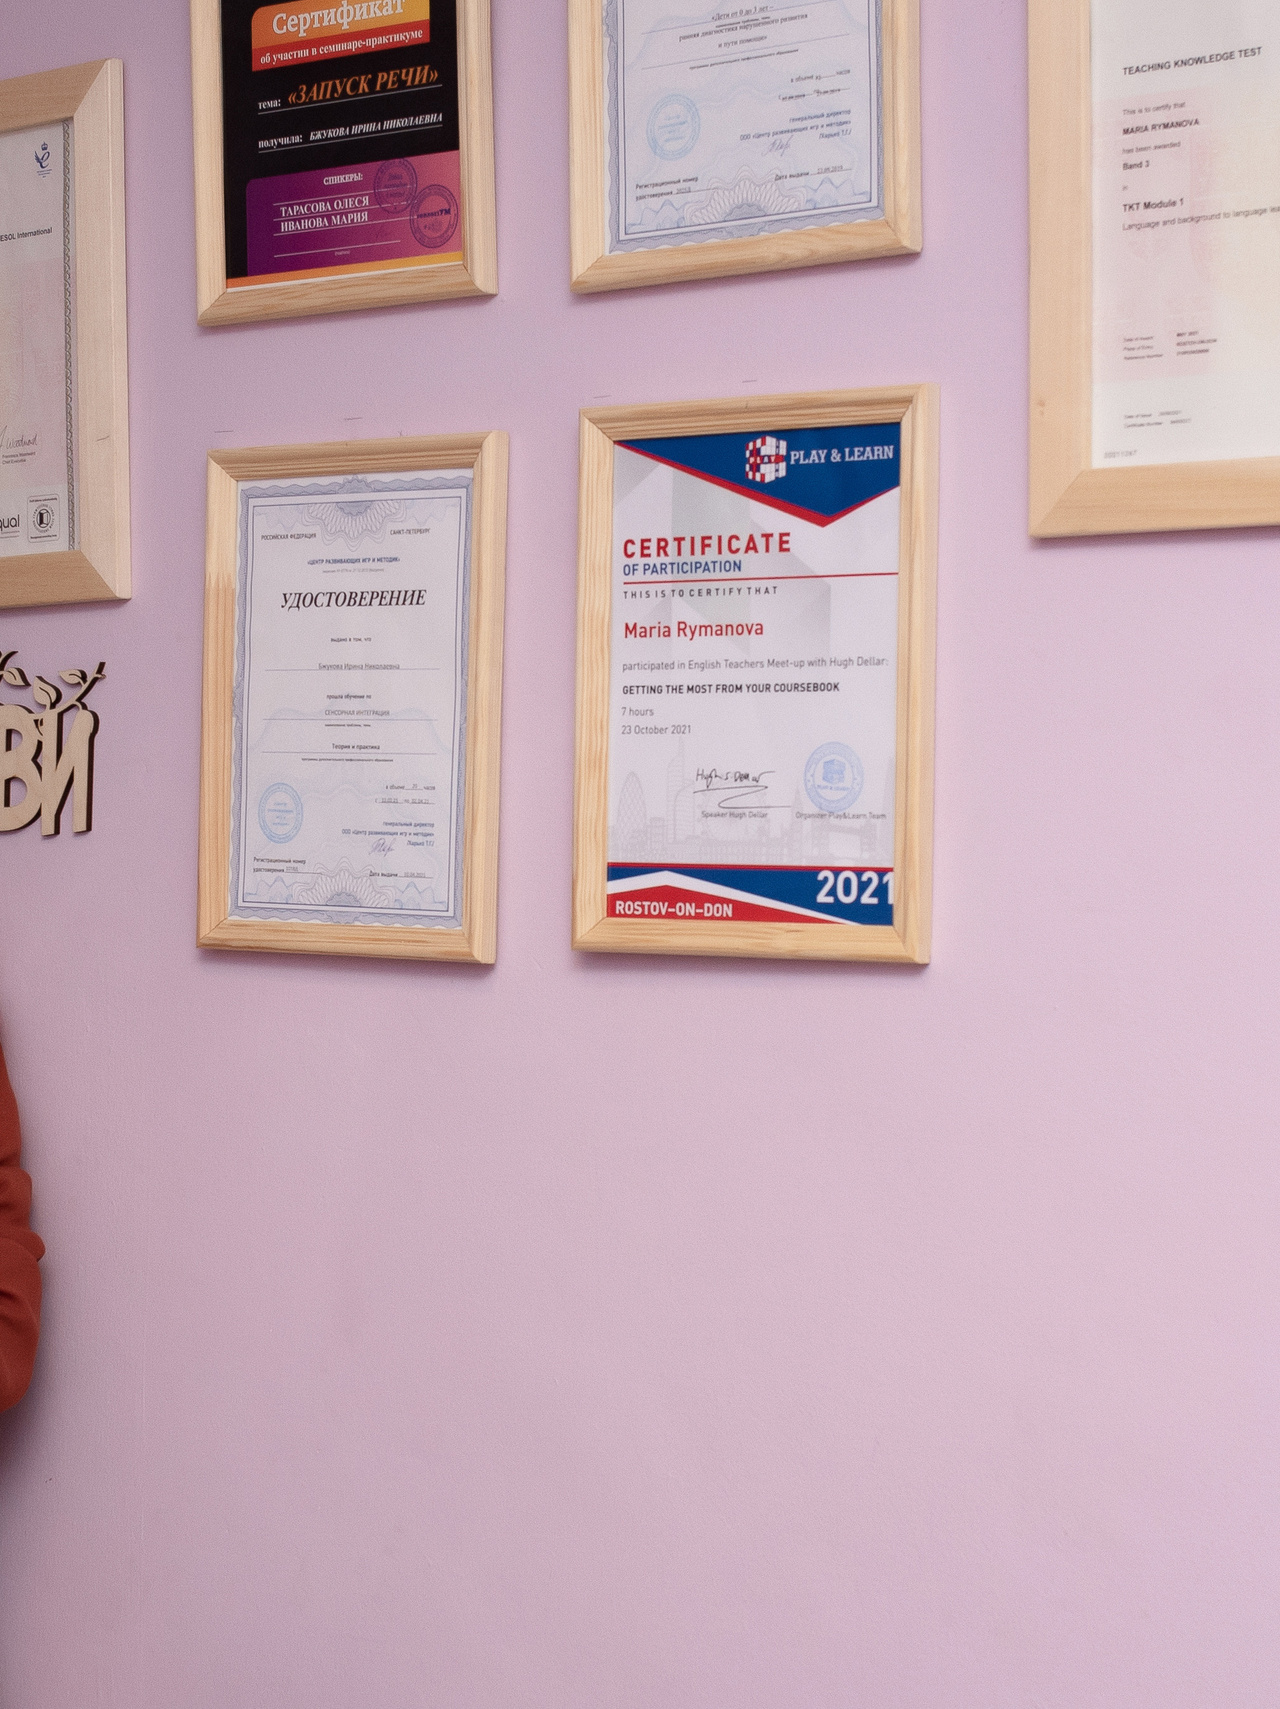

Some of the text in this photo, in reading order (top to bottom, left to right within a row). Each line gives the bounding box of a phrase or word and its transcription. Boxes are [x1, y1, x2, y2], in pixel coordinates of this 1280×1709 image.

[272, 0, 405, 37] Сертификат
[260, 53, 270, 64] об
[273, 48, 309, 65] участии
[319, 29, 423, 55] семинаре-практикуме
[1123, 47, 1262, 75] TEACHING KNOWLEDGE TEST
[258, 65, 439, 110] тема: «ЗАПУСК РЕЧИ»
[259, 113, 442, 149] получила: БЖУКОВА ИРИНА НИКОЛАЕВНА
[1123, 118, 1199, 135] MARIA RYMANOVA
[1123, 162, 1142, 170] Band
[323, 173, 362, 185] СПИКЕРЫ:
[280, 196, 369, 217] ТАРАСОВА ОЛЕСЯ
[1123, 203, 1140, 212] TKT
[1143, 200, 1177, 210] Module
[280, 212, 368, 232] ИВАНОВА МАРИЯ
[1123, 221, 1160, 231] Language
[1178, 213, 1221, 225] background
[1233, 208, 1267, 218] language
[0, 233, 16, 242] ESOL
[17, 227, 52, 239] International
[790, 445, 894, 464] PLAY & LEARN
[624, 532, 791, 558] CERTIFICATE
[623, 560, 742, 576] OF PARTICIPATION
[281, 589, 427, 611] УДОСТОВЕРЕНИЕ
[624, 620, 764, 641] Maria Rymanova
[622, 656, 889, 672] participated in English Teachers Meet-up with Hugh Dellar:
[622, 682, 840, 695] GETTING THE MOST FROM YOUR COURSEBOOK
[622, 707, 654, 716] 7 hours
[622, 725, 692, 734] 23 October 2021
[729, 811, 747, 819] Hugh
[816, 870, 894, 904] 2021
[616, 900, 733, 918] ROSTOV-ON-DON
